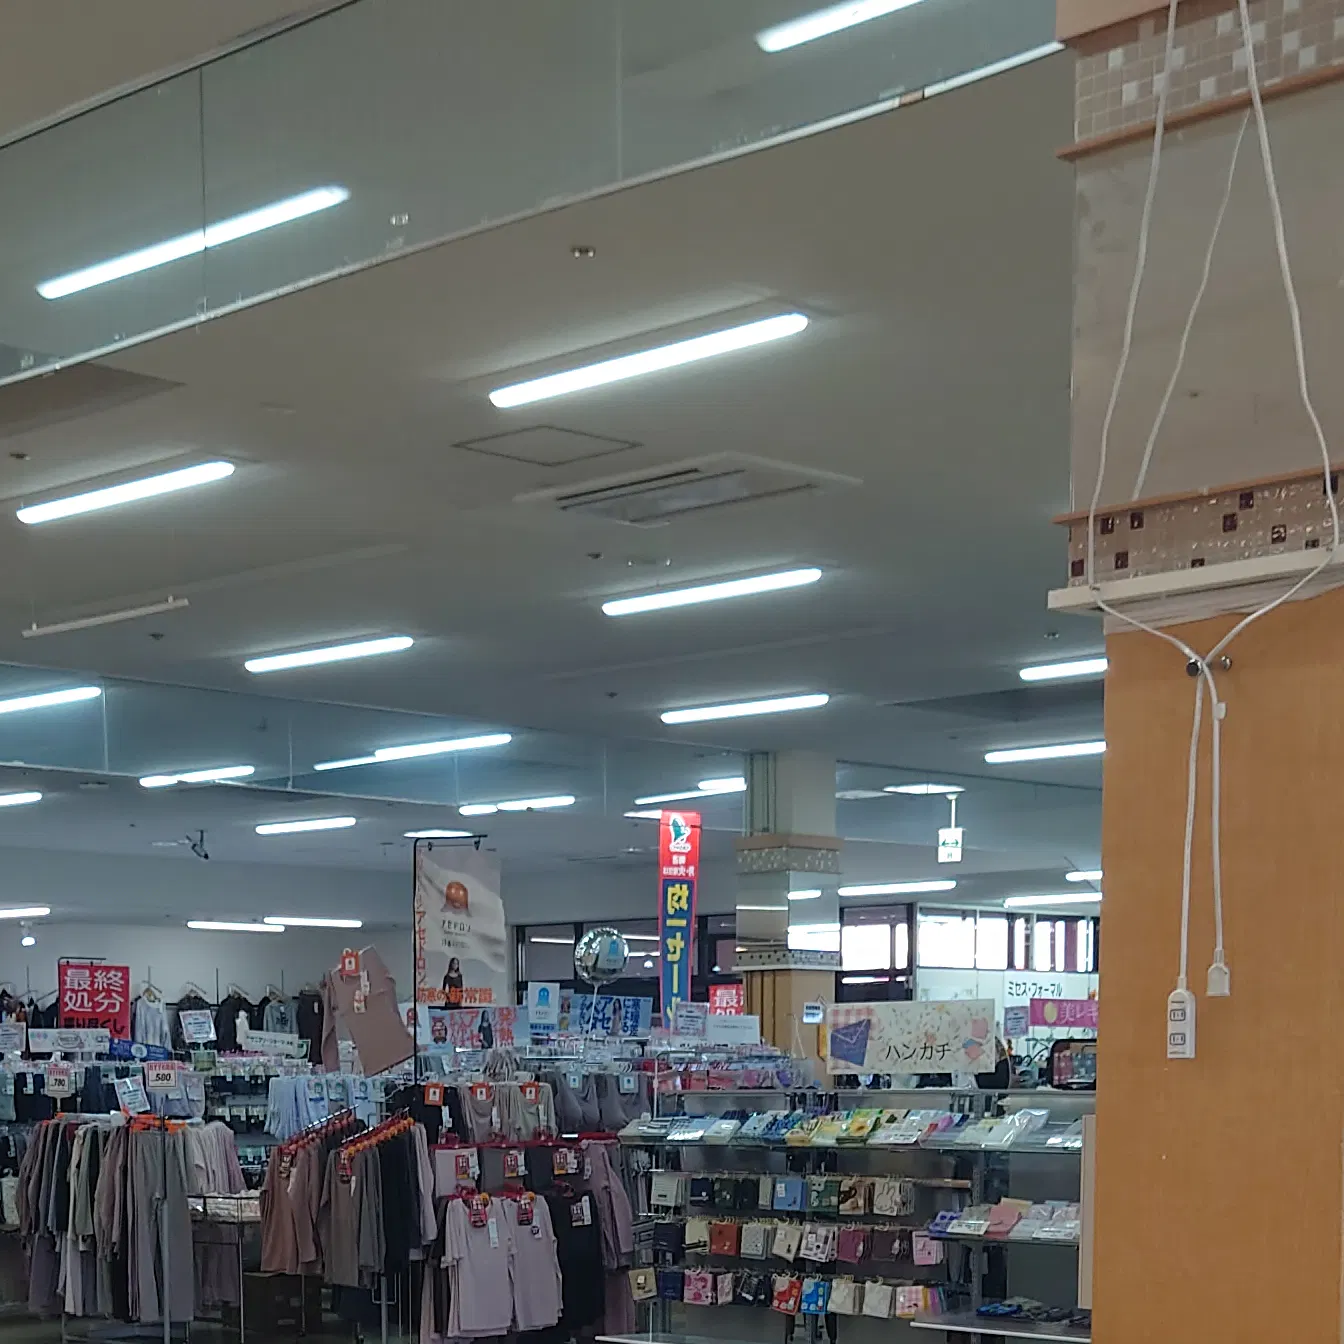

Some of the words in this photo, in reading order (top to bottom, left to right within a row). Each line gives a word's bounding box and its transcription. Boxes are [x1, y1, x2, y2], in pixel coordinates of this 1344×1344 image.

[64, 968, 125, 992] 最終
[1008, 981, 1063, 997] ミセス・フォーマル
[64, 991, 125, 1013] 処分
[886, 1041, 952, 1061] ハンカチ
